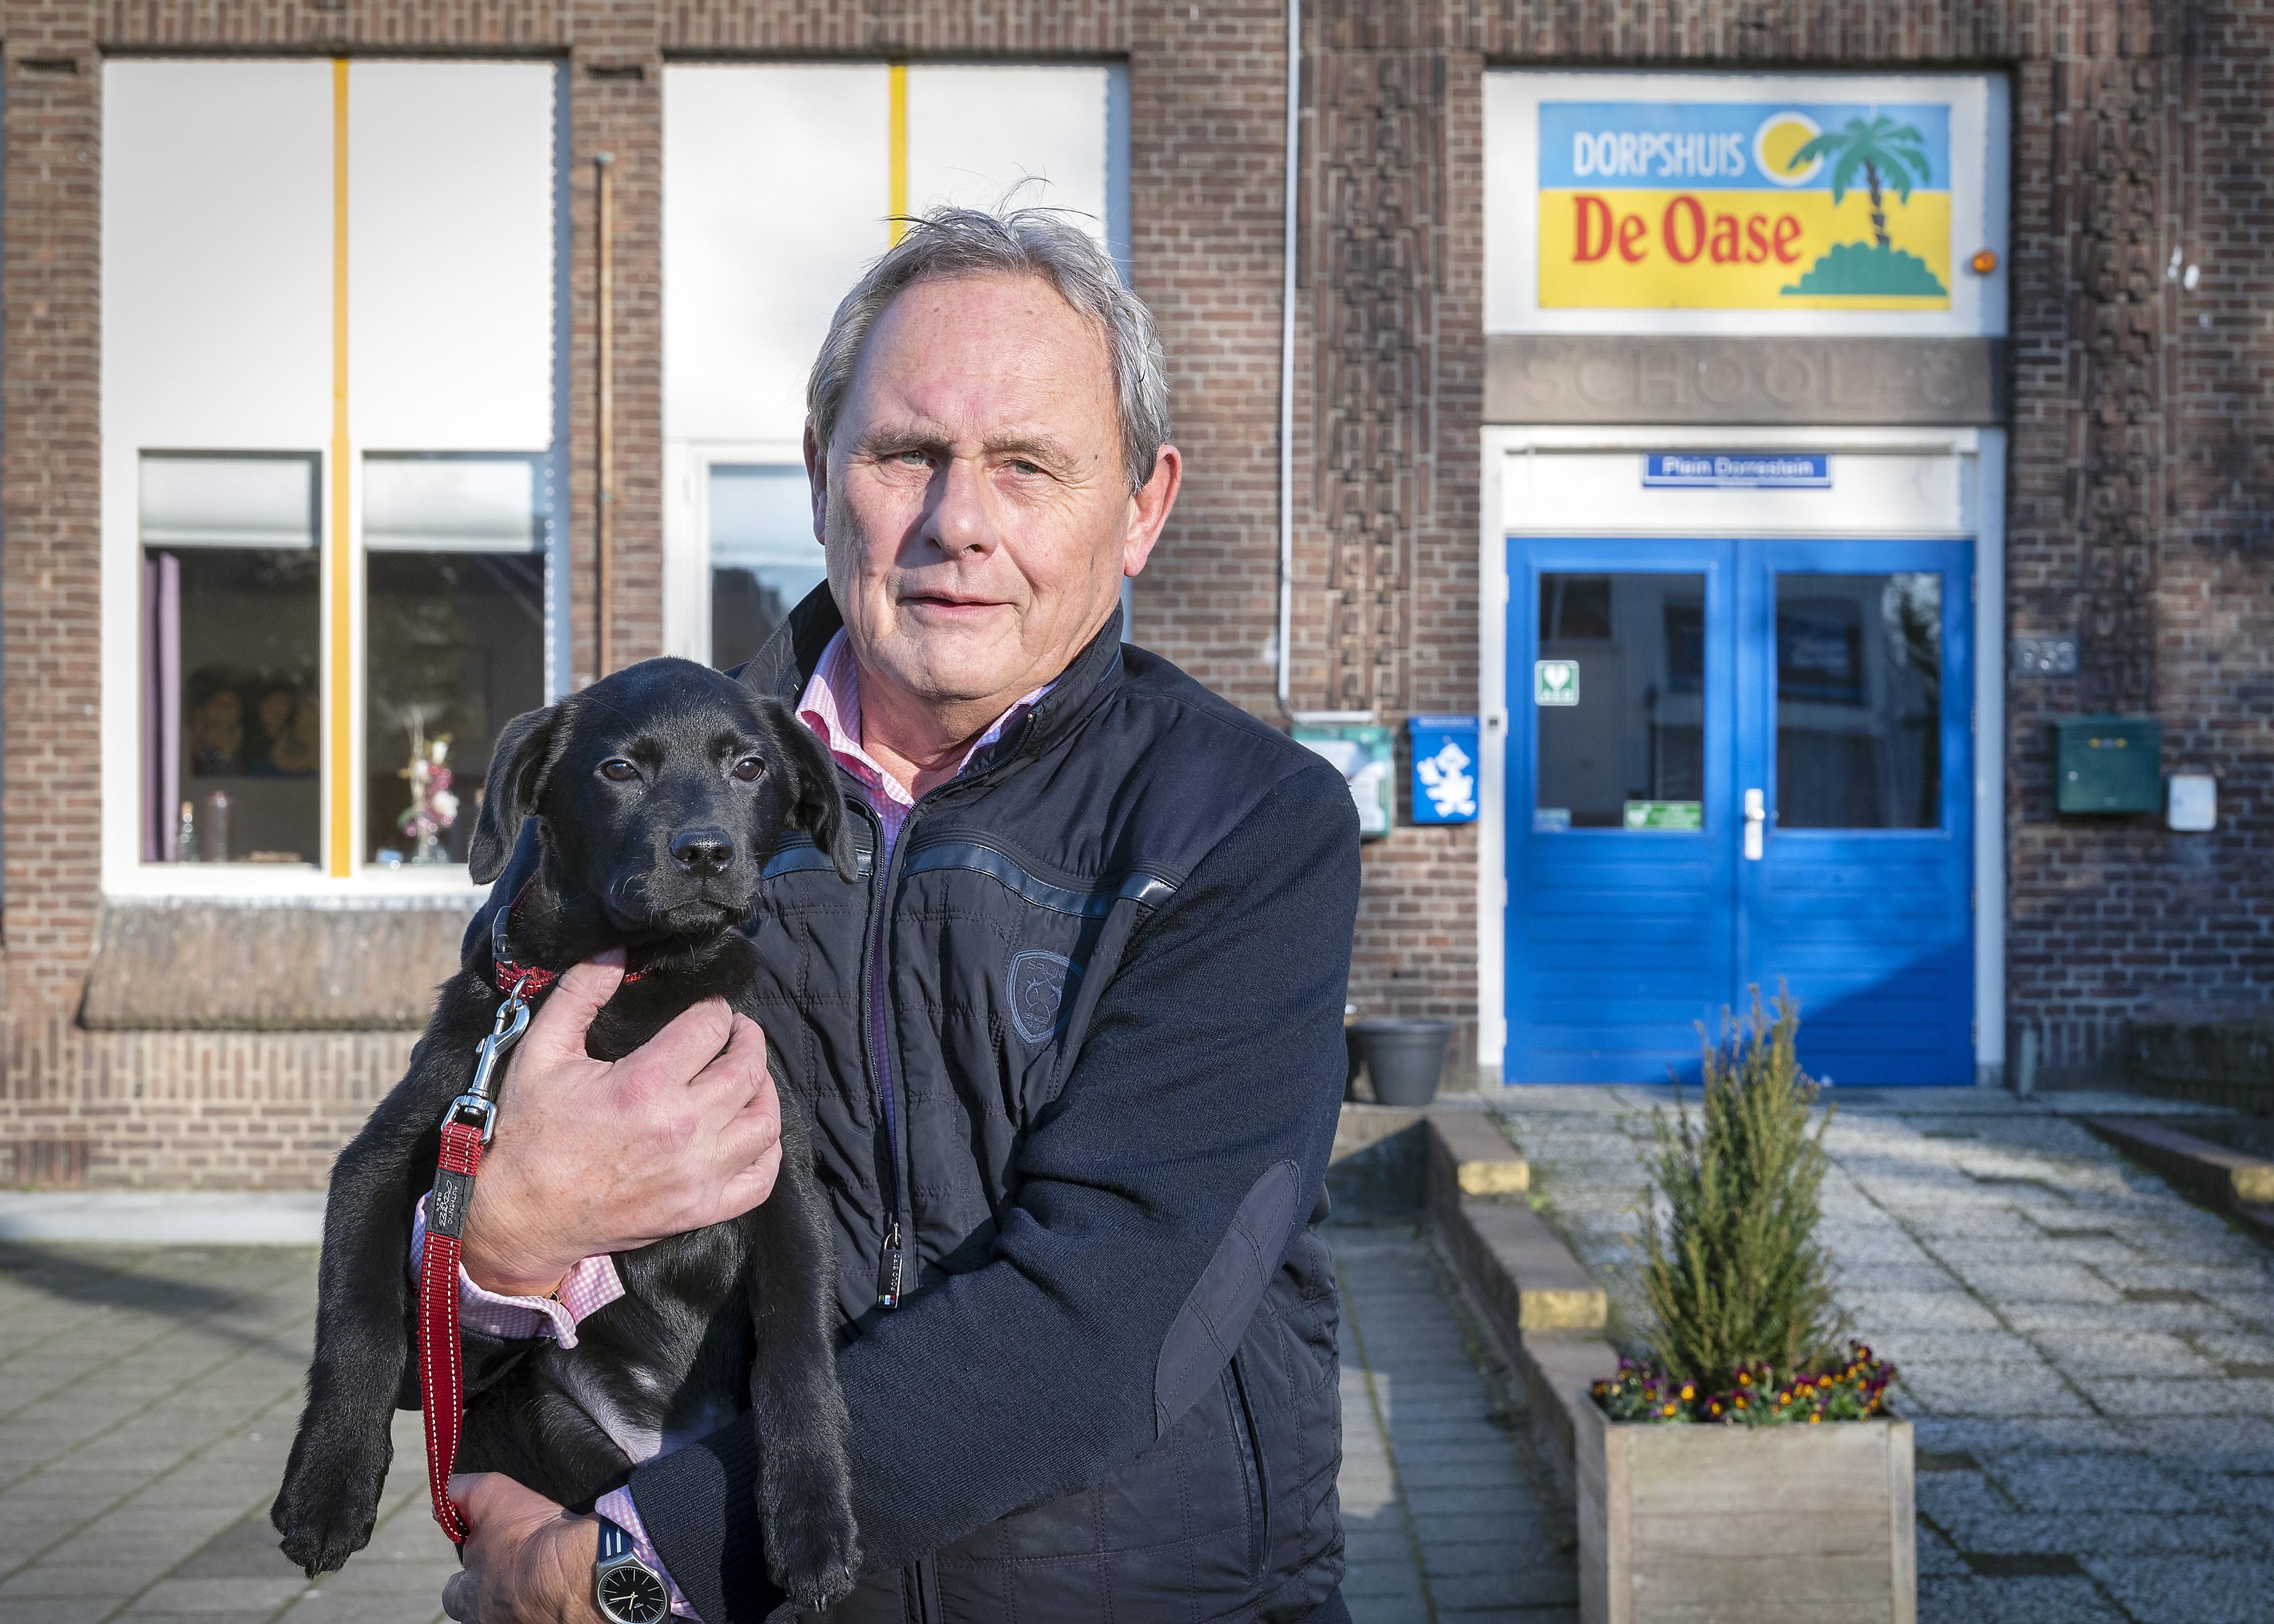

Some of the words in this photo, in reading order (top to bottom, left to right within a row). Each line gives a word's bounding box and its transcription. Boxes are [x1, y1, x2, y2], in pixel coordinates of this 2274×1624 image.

[1573, 131, 1746, 177] DORPSHUIS
[1571, 194, 1647, 264] De
[1662, 194, 1802, 264] Oase
[1521, 348, 1872, 411] SCHOOL
[447, 1186, 458, 1224] AUTHENTIC
[890, 1272, 899, 1291] POLO
